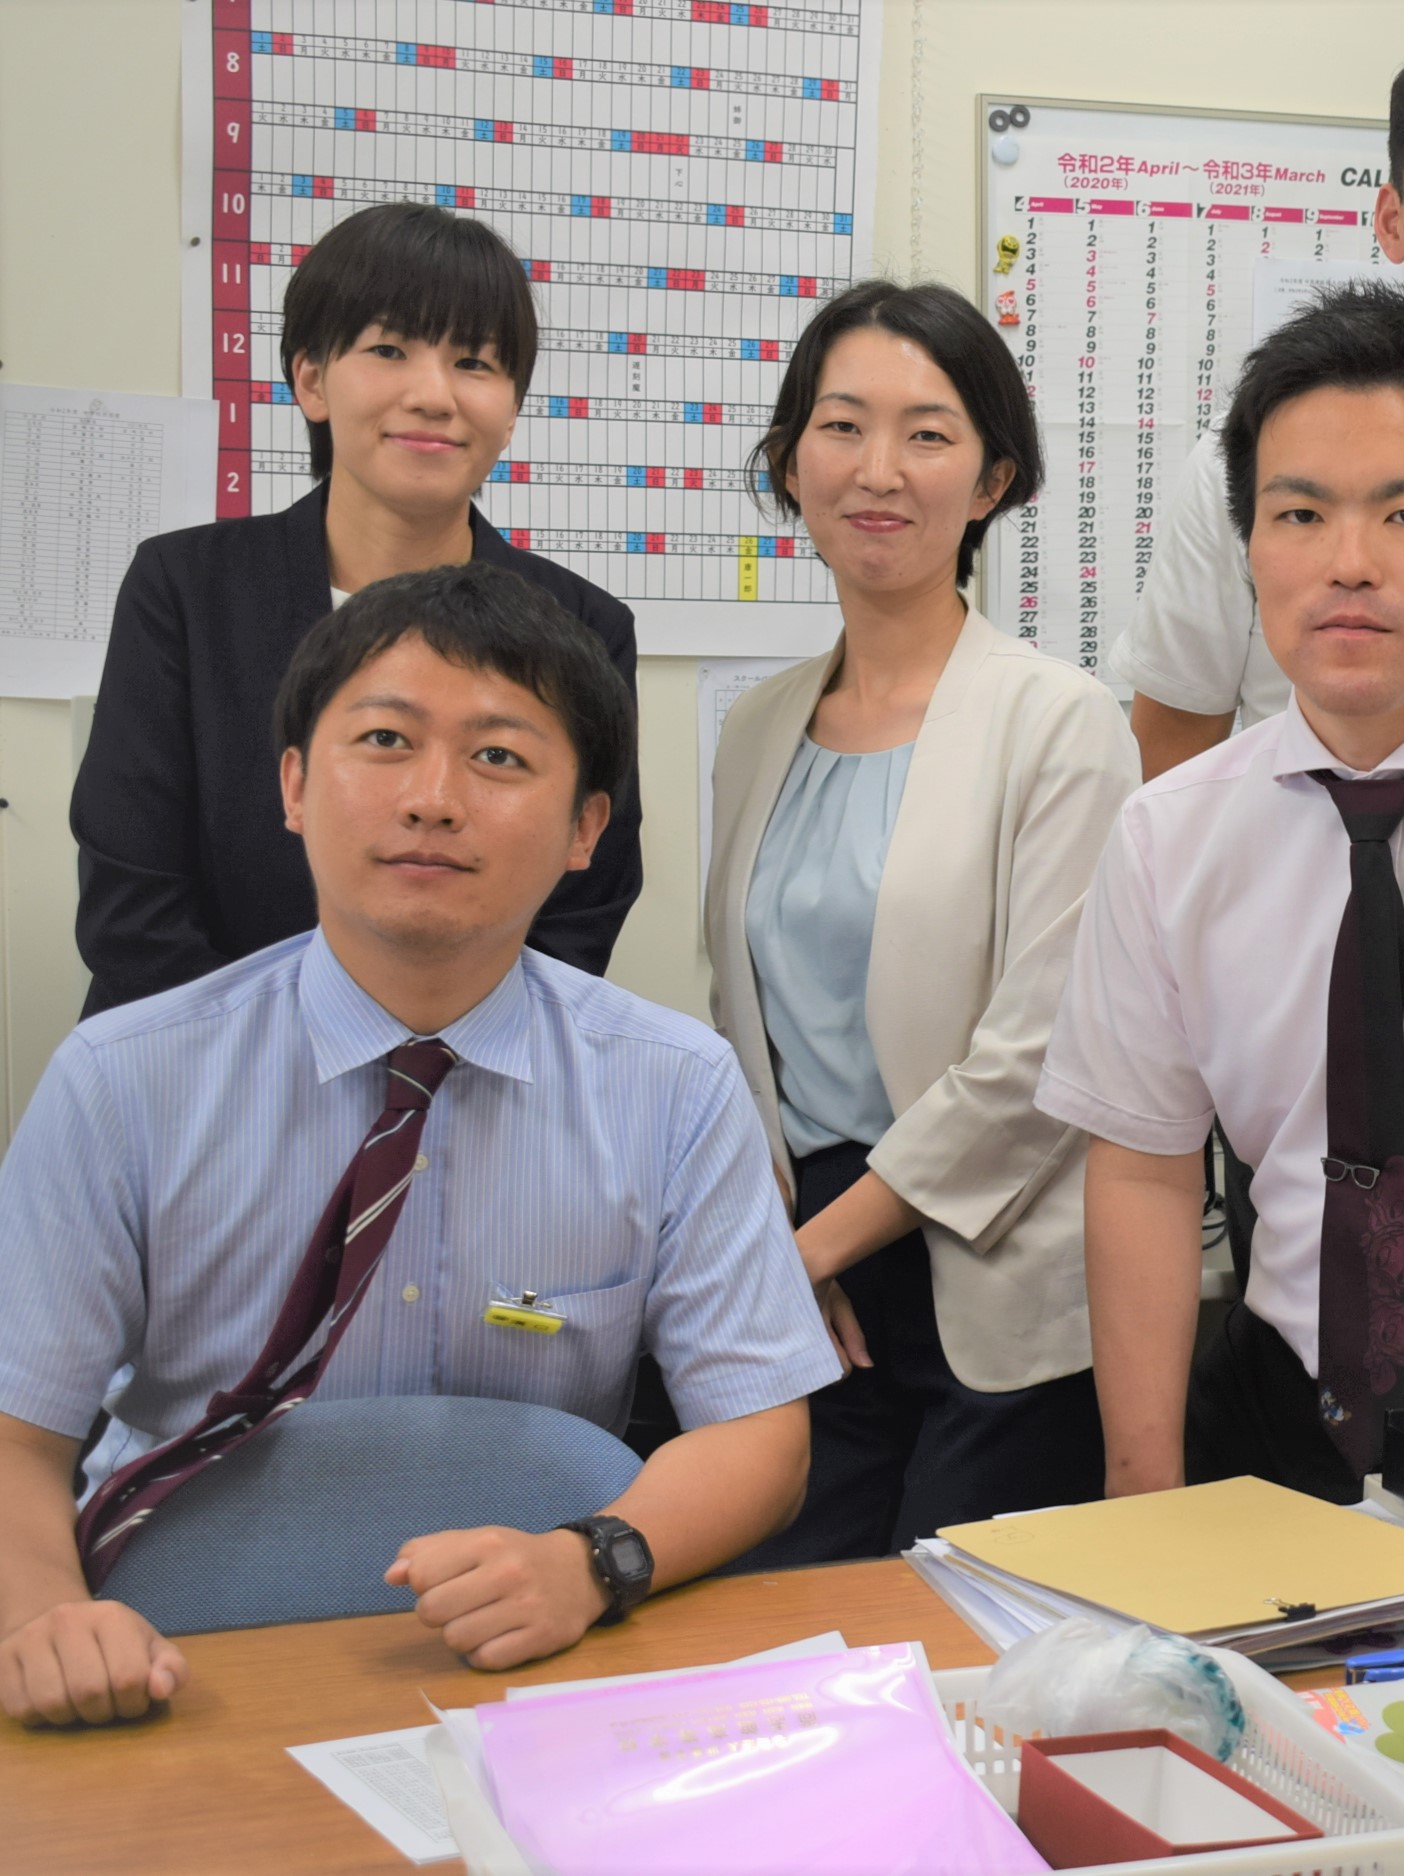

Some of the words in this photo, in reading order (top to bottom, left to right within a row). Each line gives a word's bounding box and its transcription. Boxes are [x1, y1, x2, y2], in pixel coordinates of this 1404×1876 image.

[226, 52, 240, 73] 8
[227, 122, 240, 143] 9
[223, 193, 245, 214] 10
[1027, 216, 1035, 230] 1
[1087, 219, 1095, 232] 1
[1148, 221, 1156, 234] 1
[1207, 224, 1215, 236] 1
[1025, 232, 1038, 245] 2
[1262, 226, 1269, 239] 1
[1315, 228, 1323, 241] 1
[1086, 234, 1098, 247] 2
[1146, 236, 1158, 249] 2
[1206, 238, 1217, 252] 2
[1260, 241, 1271, 254] 2
[1025, 247, 1037, 261] 3
[1086, 249, 1097, 263] 3
[1314, 243, 1324, 256] 2
[1370, 246, 1381, 259] 2
[1146, 251, 1157, 265] 3
[1206, 253, 1216, 267] 3
[223, 263, 241, 284] 11
[1025, 263, 1036, 276] 4
[1085, 265, 1097, 278] 4
[1145, 267, 1156, 279] 4
[1205, 269, 1216, 281] 4
[1025, 278, 1037, 292] 5
[1086, 280, 1097, 293] 5
[1146, 281, 1156, 295] 5
[1206, 284, 1216, 297] 5
[1025, 293, 1036, 307] 6
[1086, 295, 1097, 308] 6
[1145, 297, 1156, 310] 6
[1206, 298, 1216, 312] 6
[1026, 308, 1037, 322] 7
[1087, 310, 1097, 323] 7
[1147, 312, 1157, 325] 7
[1207, 313, 1217, 326] 7
[1025, 324, 1037, 337] 8
[1085, 325, 1097, 339] 8
[1145, 327, 1156, 340] 8
[1205, 328, 1216, 342] 8
[223, 333, 245, 354] 12
[1026, 339, 1037, 353] 9
[1086, 340, 1097, 354] 9
[1145, 342, 1156, 355] 9
[1205, 343, 1216, 357] 9
[1078, 356, 1096, 369] 10
[1137, 357, 1155, 370] 10
[1197, 358, 1214, 372] 10
[1078, 370, 1094, 384] 11
[1137, 372, 1153, 385] 11
[1197, 373, 1212, 386] 11
[1078, 386, 1096, 399] 12
[1137, 387, 1155, 400] 12
[1196, 388, 1213, 401] 12
[230, 403, 235, 423] 1
[1078, 401, 1096, 414] 13
[1137, 402, 1155, 415] 13
[1196, 403, 1212, 416] 13
[1079, 416, 1097, 429] 14
[1138, 417, 1155, 430] 14
[1196, 418, 1210, 432] 14
[1078, 430, 1096, 444] 15
[1137, 431, 1155, 445] 15
[1078, 446, 1096, 459] 16
[1136, 446, 1154, 460] 16
[1078, 461, 1096, 474] 17
[1136, 461, 1155, 475] 17
[227, 472, 239, 492] 2
[1078, 476, 1096, 489] 18
[1136, 476, 1154, 490] 18
[1078, 491, 1096, 504] 19
[1136, 491, 1154, 505] 19
[1019, 504, 1039, 519] 20
[1077, 506, 1097, 519] 20
[1134, 506, 1154, 520] 20
[1019, 520, 1037, 534] 21
[1077, 521, 1095, 534] 21
[1134, 521, 1152, 534] 21
[1019, 535, 1040, 549] 22
[1078, 535, 1098, 549] 22
[1134, 536, 1154, 549] 22
[1019, 550, 1039, 564] 23
[1078, 550, 1097, 564] 23
[1134, 551, 1152, 564] 23
[1019, 566, 1039, 579] 24
[1079, 565, 1097, 579] 24
[1019, 580, 1039, 594] 25
[1079, 580, 1098, 594] 25
[1018, 595, 1039, 609] 26
[1079, 595, 1098, 609] 26
[1018, 610, 1039, 624] 27
[1079, 610, 1099, 624] 27
[1018, 625, 1038, 639] 28
[1079, 625, 1098, 639] 28
[1079, 640, 1098, 654] 29
[1078, 655, 1098, 669] 30
